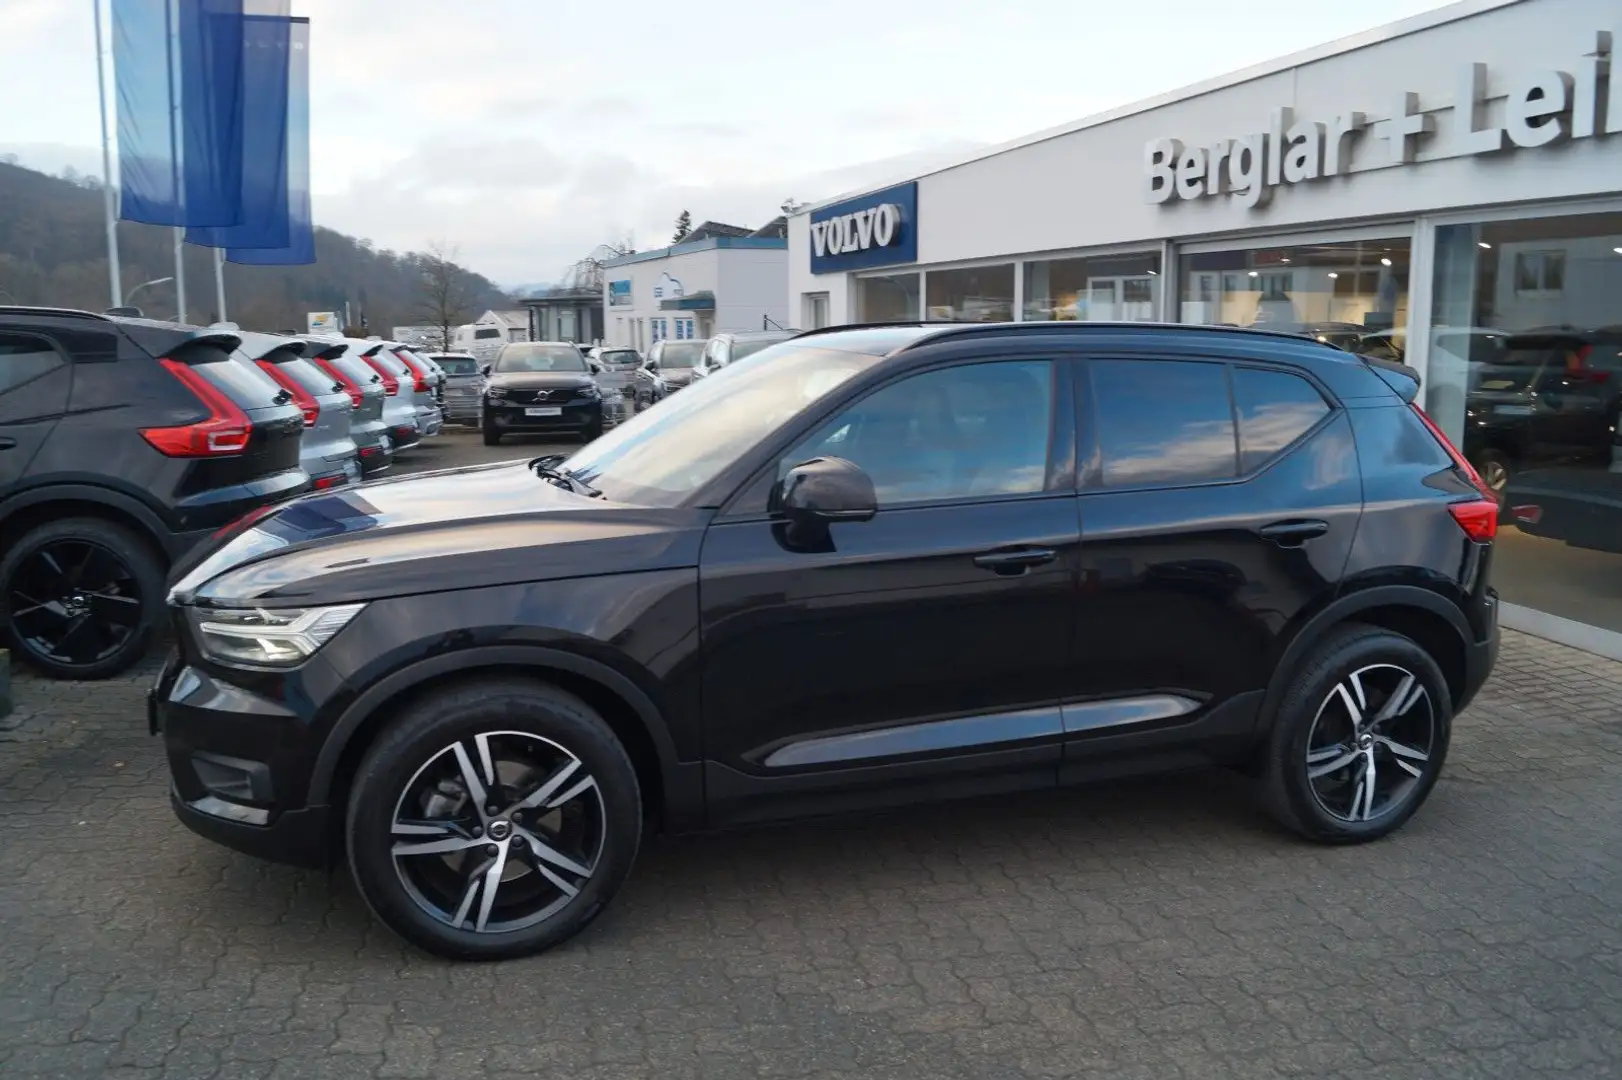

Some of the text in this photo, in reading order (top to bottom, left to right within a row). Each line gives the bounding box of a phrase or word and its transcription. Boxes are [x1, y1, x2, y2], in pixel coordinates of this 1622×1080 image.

[1144, 107, 1358, 209] Berglar
[1374, 92, 1428, 165] +
[811, 204, 896, 257] VOLVO
